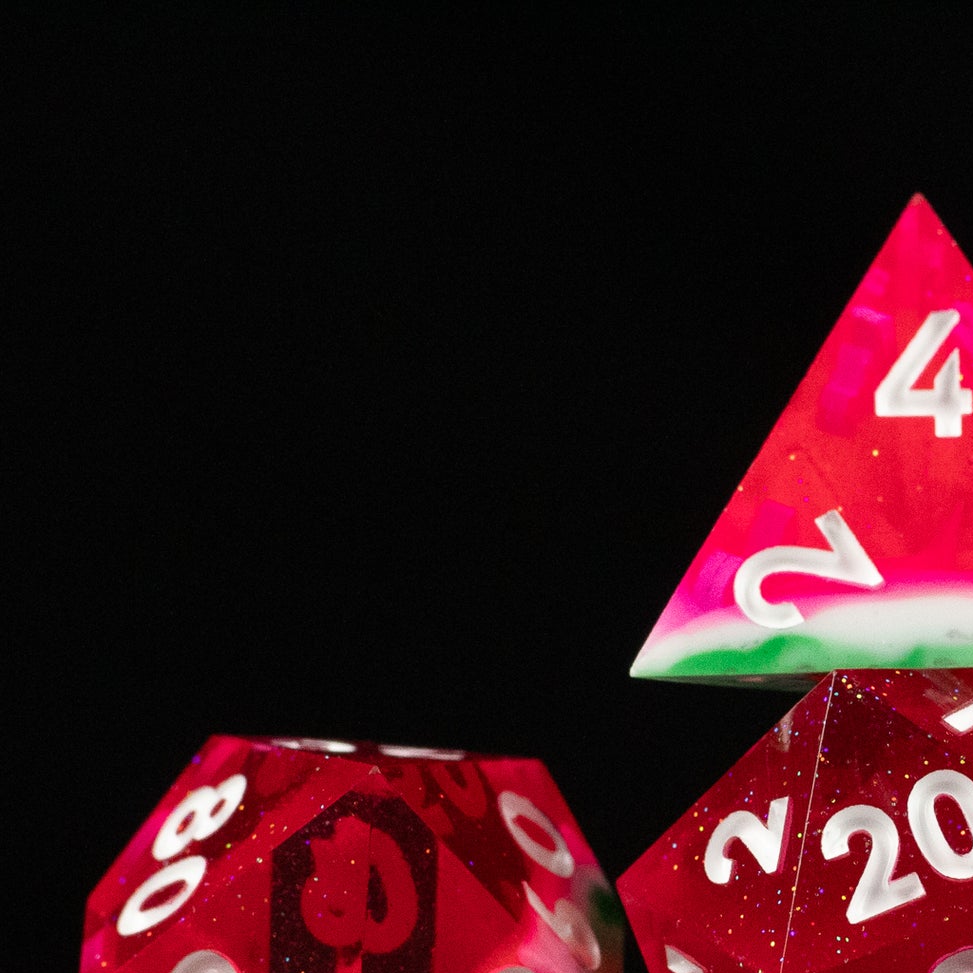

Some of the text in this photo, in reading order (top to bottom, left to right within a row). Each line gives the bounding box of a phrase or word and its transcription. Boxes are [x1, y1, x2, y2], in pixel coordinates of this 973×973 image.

[875, 309, 973, 438] 4
[733, 509, 885, 629] 2
[116, 773, 247, 936] 80
[703, 796, 794, 886] 2
